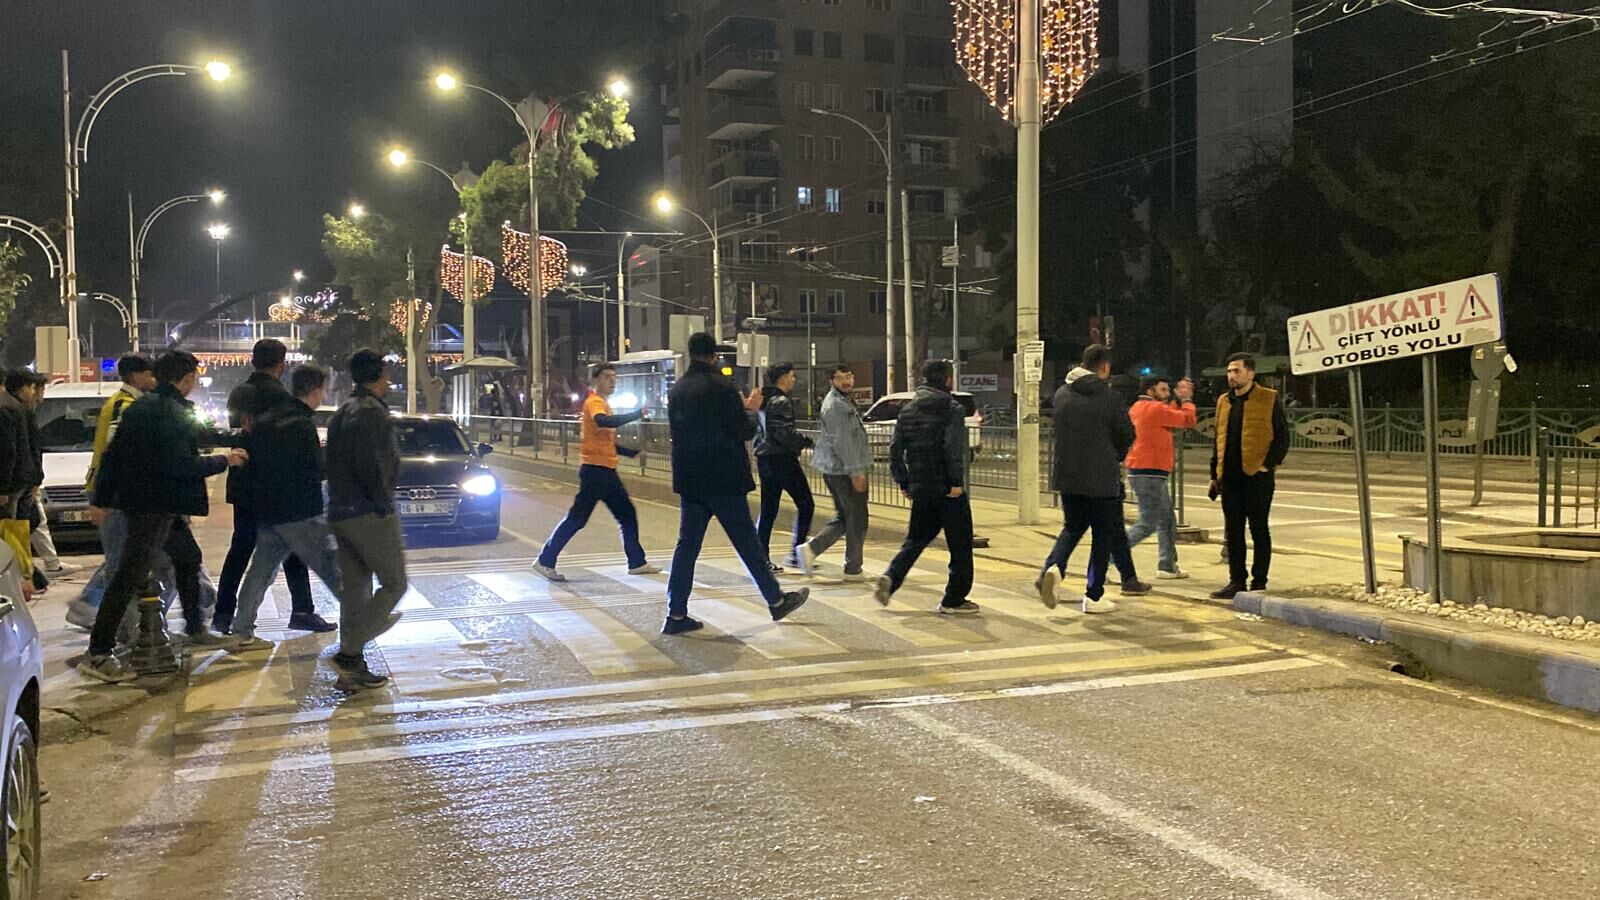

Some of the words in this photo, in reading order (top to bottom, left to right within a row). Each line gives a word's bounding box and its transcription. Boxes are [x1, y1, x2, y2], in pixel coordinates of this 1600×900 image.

[1328, 291, 1447, 336] DİKKAT!
[1322, 344, 1399, 367] OTOBÜS
[1406, 333, 1462, 352] YOLU
[1338, 331, 1375, 350] ÇİFT
[1380, 317, 1440, 340] YÖNLÜ
[960, 376, 996, 386] CZANE
